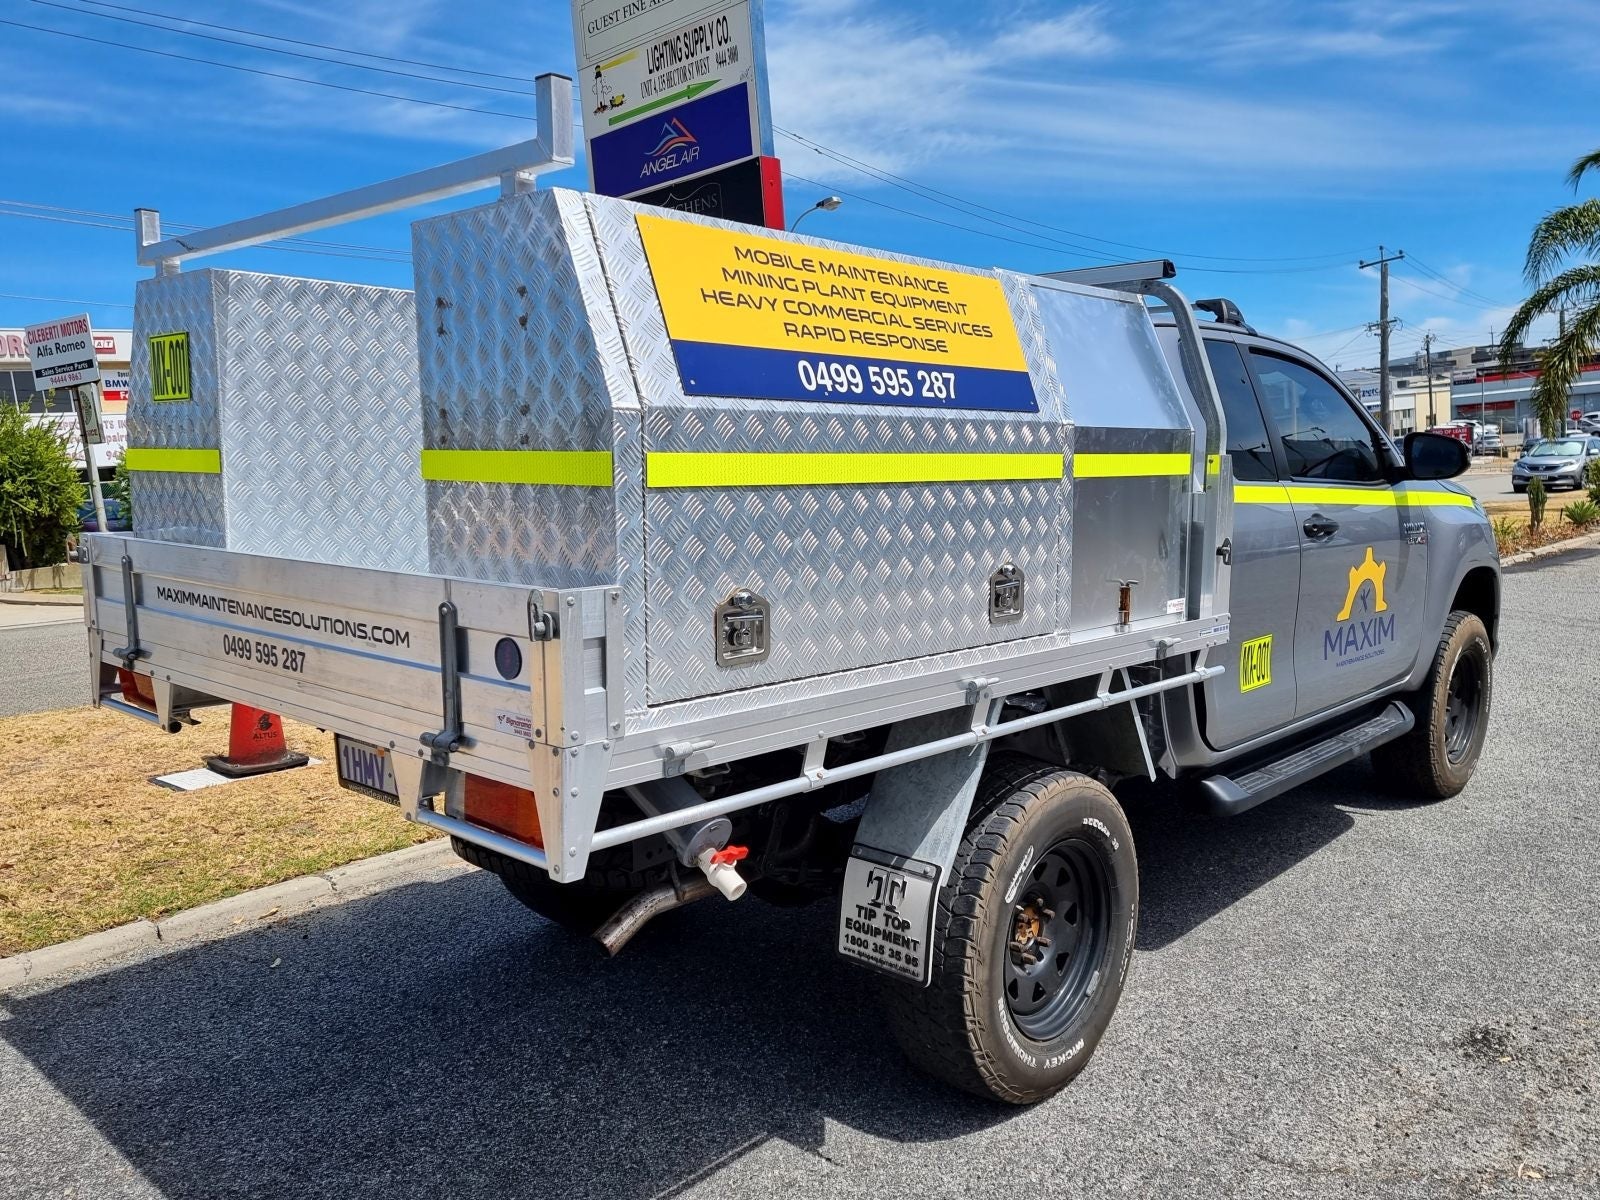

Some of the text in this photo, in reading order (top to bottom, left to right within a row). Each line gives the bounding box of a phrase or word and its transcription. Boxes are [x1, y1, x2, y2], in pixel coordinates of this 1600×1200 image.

[587, 0, 647, 34] GUEST FINE
[646, 15, 732, 75] LIGHTING SUPPLY CO.
[640, 78, 653, 99] UNIT
[666, 65, 688, 90] HECTOR
[687, 62, 695, 81] ST
[694, 56, 710, 77] WEST
[734, 246, 950, 295] MOBILE MAINTENANCE
[721, 267, 968, 317] MINING PLANT EQUIPMENT
[60, 318, 88, 338] MOTORS
[700, 288, 993, 338] HEAVY COMMERCIAL SERVICES
[37, 340, 86, 358] Alfa Romeo
[783, 322, 949, 354] RAPID RESPONSE
[41, 361, 88, 377] Sales Service Parts
[152, 339, 188, 397] MX-001
[797, 359, 956, 400] 0499 595 287
[156, 586, 410, 648] MAXIMMAINTENANCESOLUTIONS.COM
[1324, 613, 1395, 660] MAXIM
[223, 634, 306, 674] 0499 595 287
[1242, 642, 1270, 687] MX-001
[253, 731, 278, 740] ALTUS
[343, 744, 385, 790] 1HMV
[845, 917, 920, 952] EQUIPMENT
[856, 904, 911, 933] TIP TOP
[844, 933, 869, 949] 1800
[1044, 1038, 1085, 1069] MICKEY
